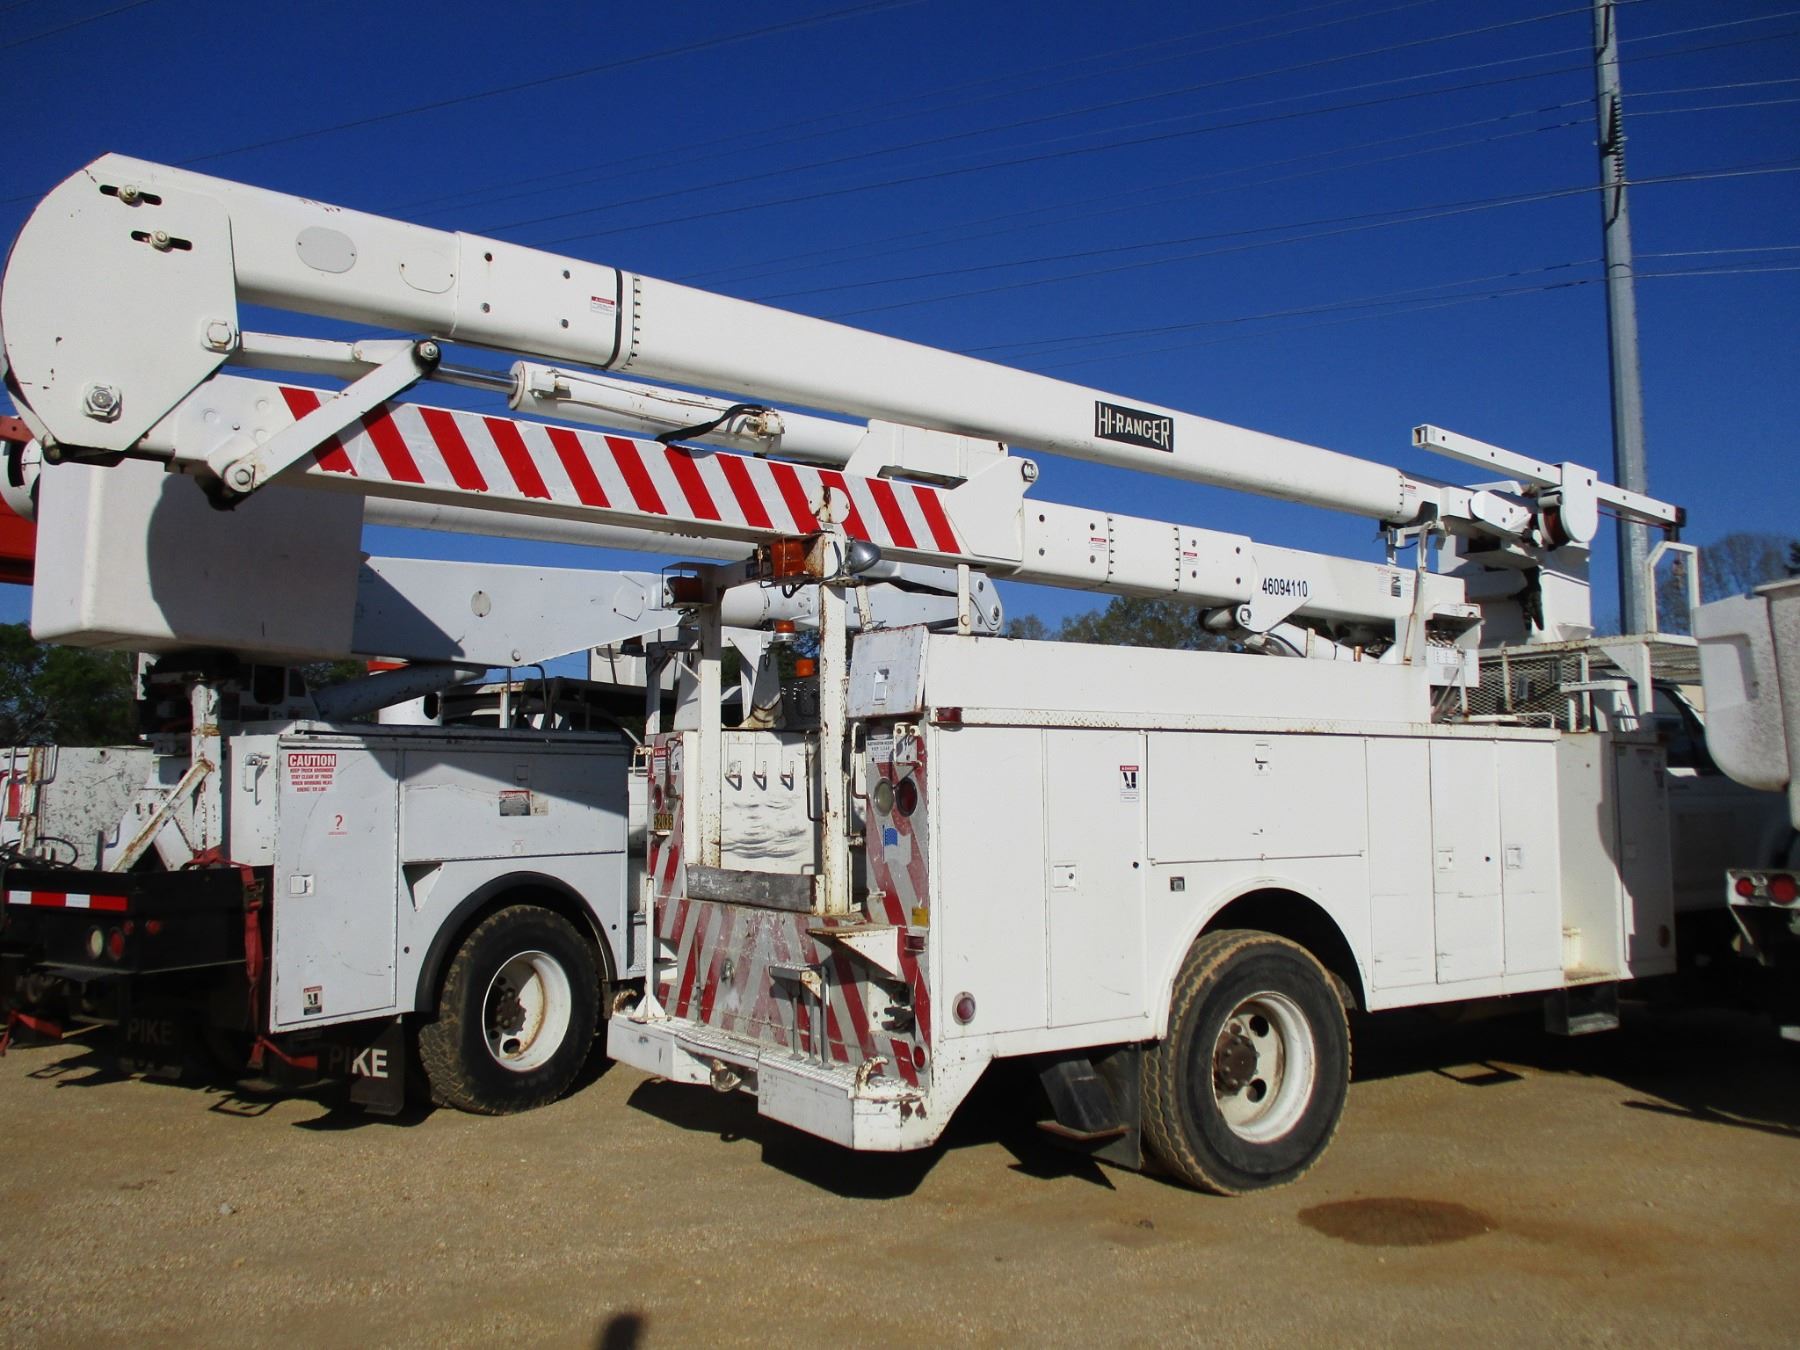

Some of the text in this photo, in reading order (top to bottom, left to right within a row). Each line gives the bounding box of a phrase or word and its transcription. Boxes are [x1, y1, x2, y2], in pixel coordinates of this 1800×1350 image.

[1098, 402, 1170, 450] HI-RANGER
[1262, 577, 1308, 597] 46094110
[289, 755, 335, 767] CAUTION
[328, 1046, 389, 1079] PIKE
